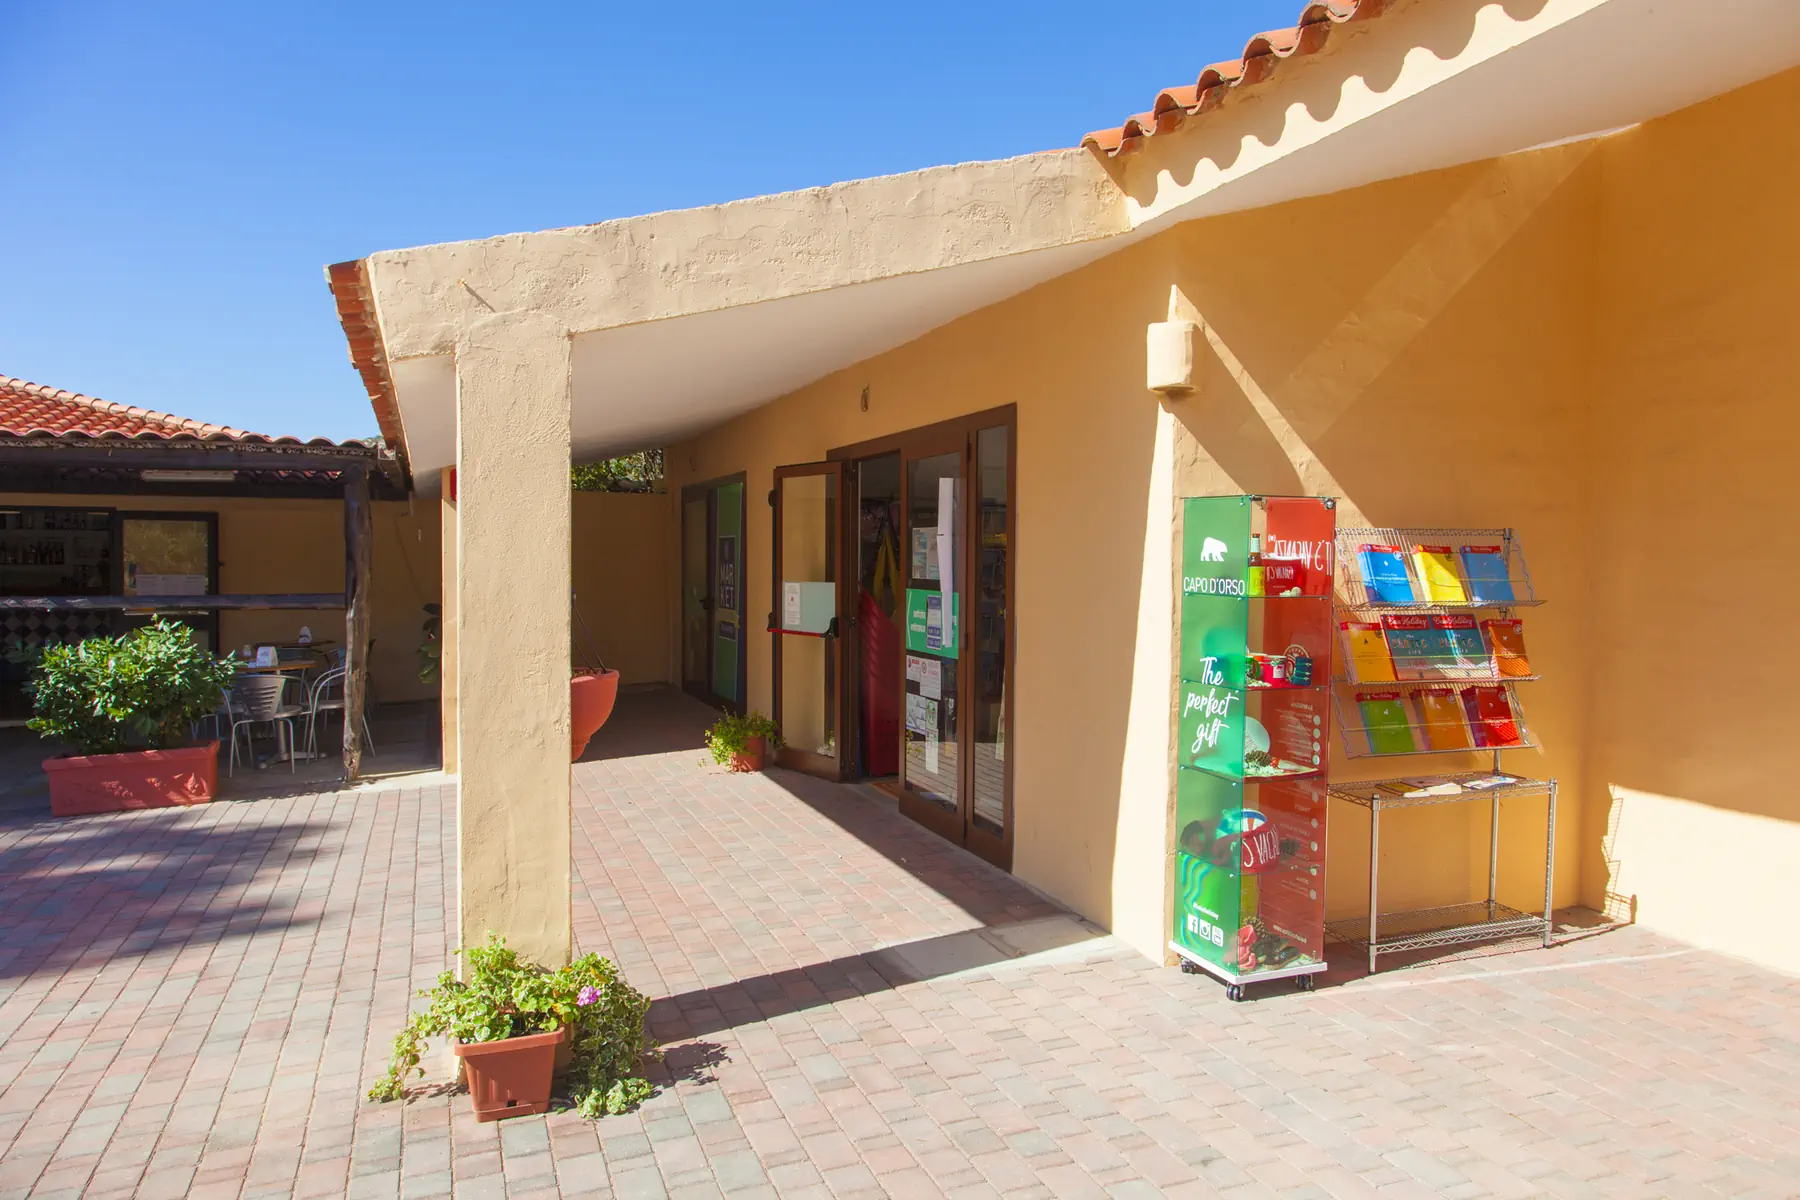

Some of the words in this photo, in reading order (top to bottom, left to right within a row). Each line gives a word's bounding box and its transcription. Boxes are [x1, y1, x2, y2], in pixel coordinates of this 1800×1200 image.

[720, 563, 734, 585] MAR
[1184, 576, 1208, 593] CAPO
[1209, 577, 1246, 595] D'ORSO
[720, 586, 734, 608] KET
[1401, 616, 1427, 628] Holiday
[1200, 656, 1224, 686] The
[1183, 688, 1240, 718] perfect
[1191, 718, 1231, 754] gift
